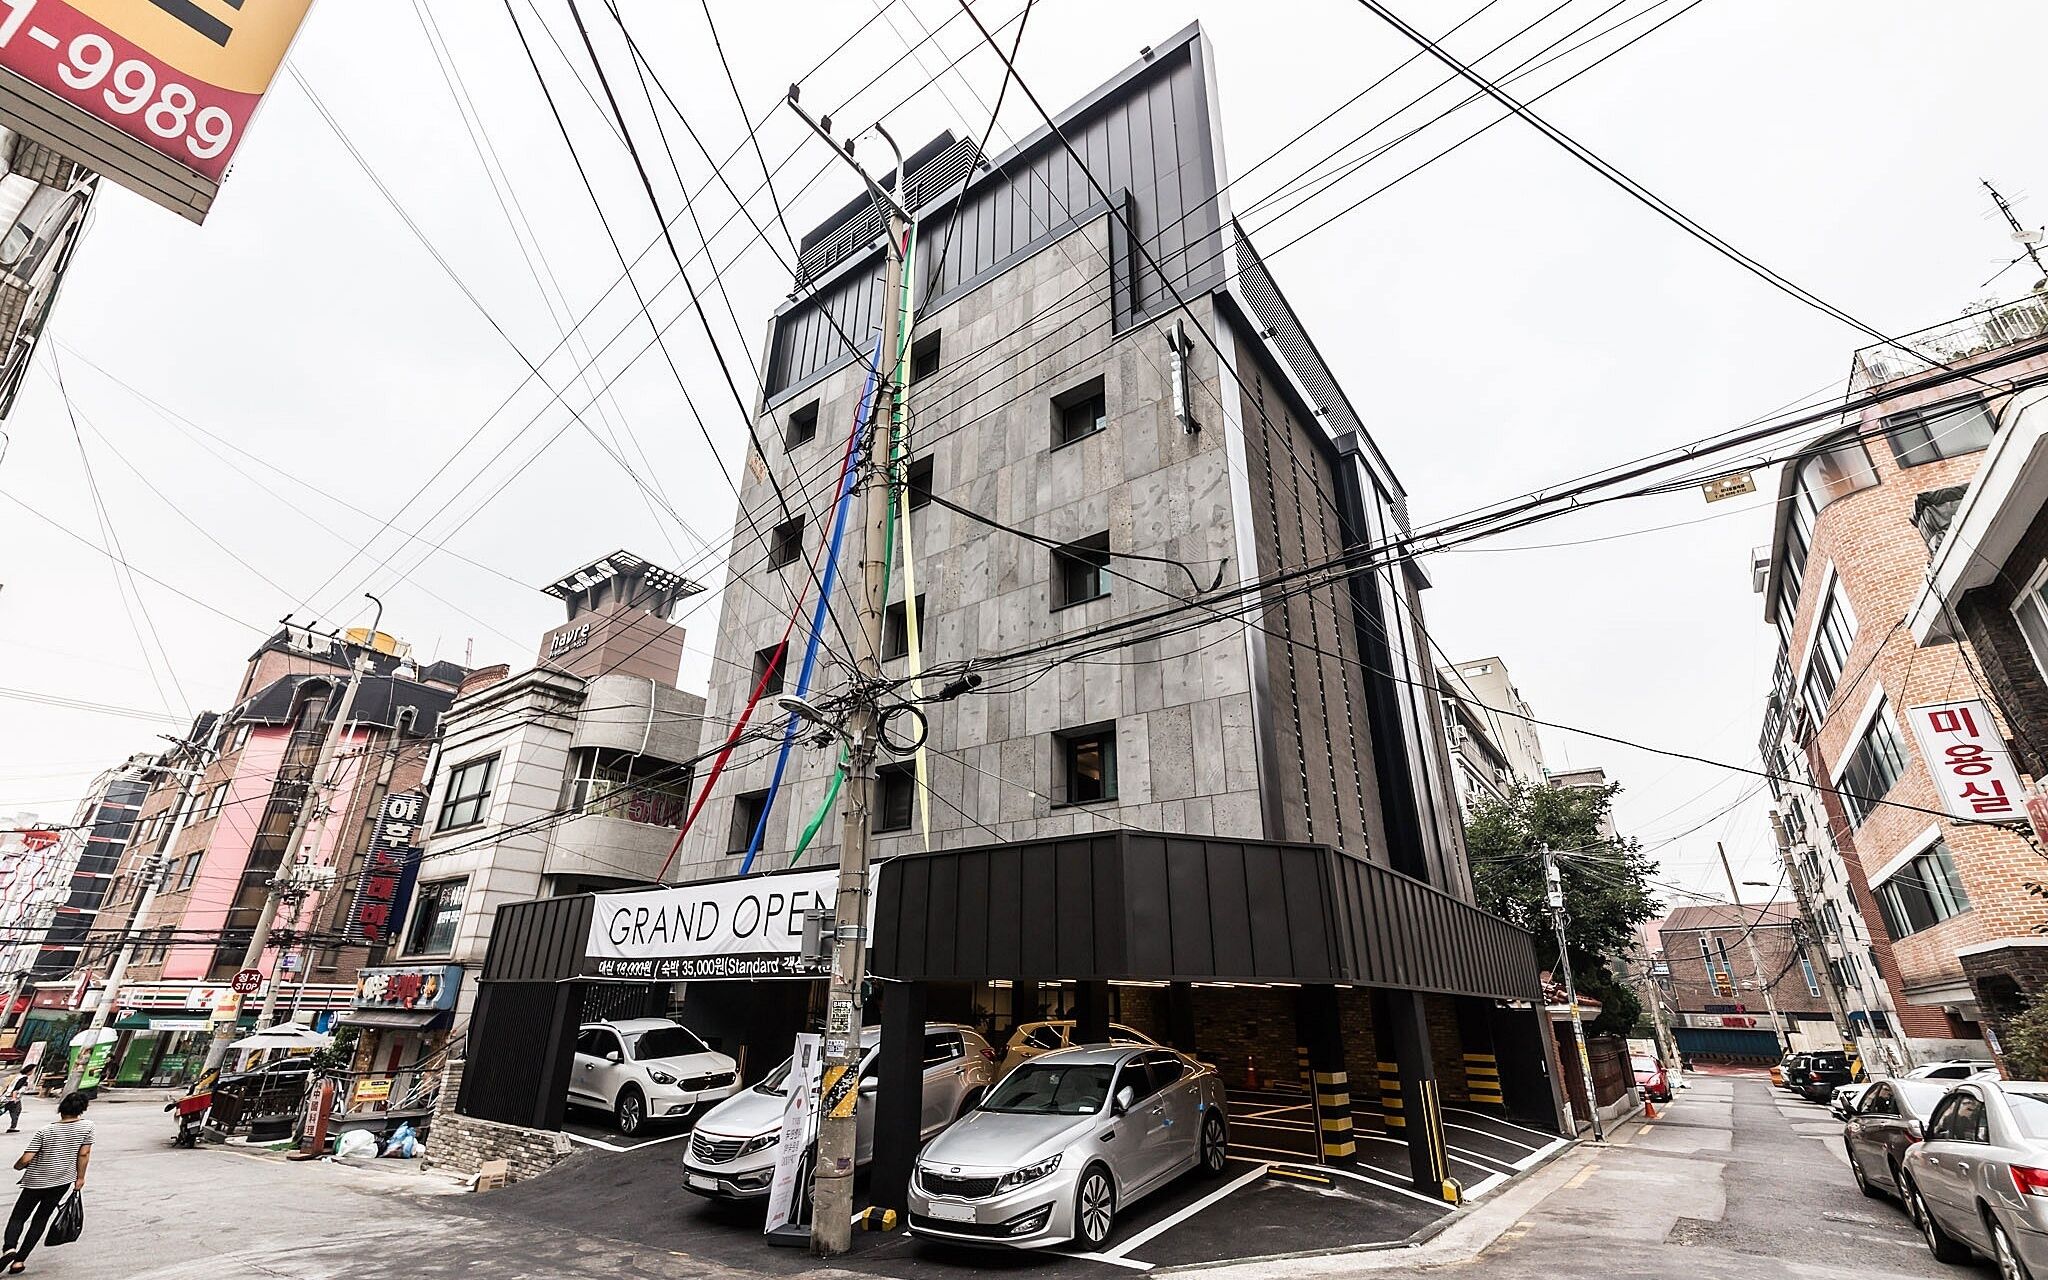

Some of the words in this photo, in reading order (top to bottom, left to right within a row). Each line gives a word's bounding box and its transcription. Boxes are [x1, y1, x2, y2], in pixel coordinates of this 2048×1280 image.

[550, 623, 590, 652] havre
[1928, 707, 2013, 814] 미용실
[381, 799, 419, 848] 야후
[359, 850, 402, 942] 노래방
[608, 901, 719, 946] GRAND
[234, 982, 259, 991] STOP
[238, 973, 261, 984] 정지
[598, 960, 616, 976] 대실
[616, 960, 653, 977] 18,000원
[661, 960, 680, 978] 숙박
